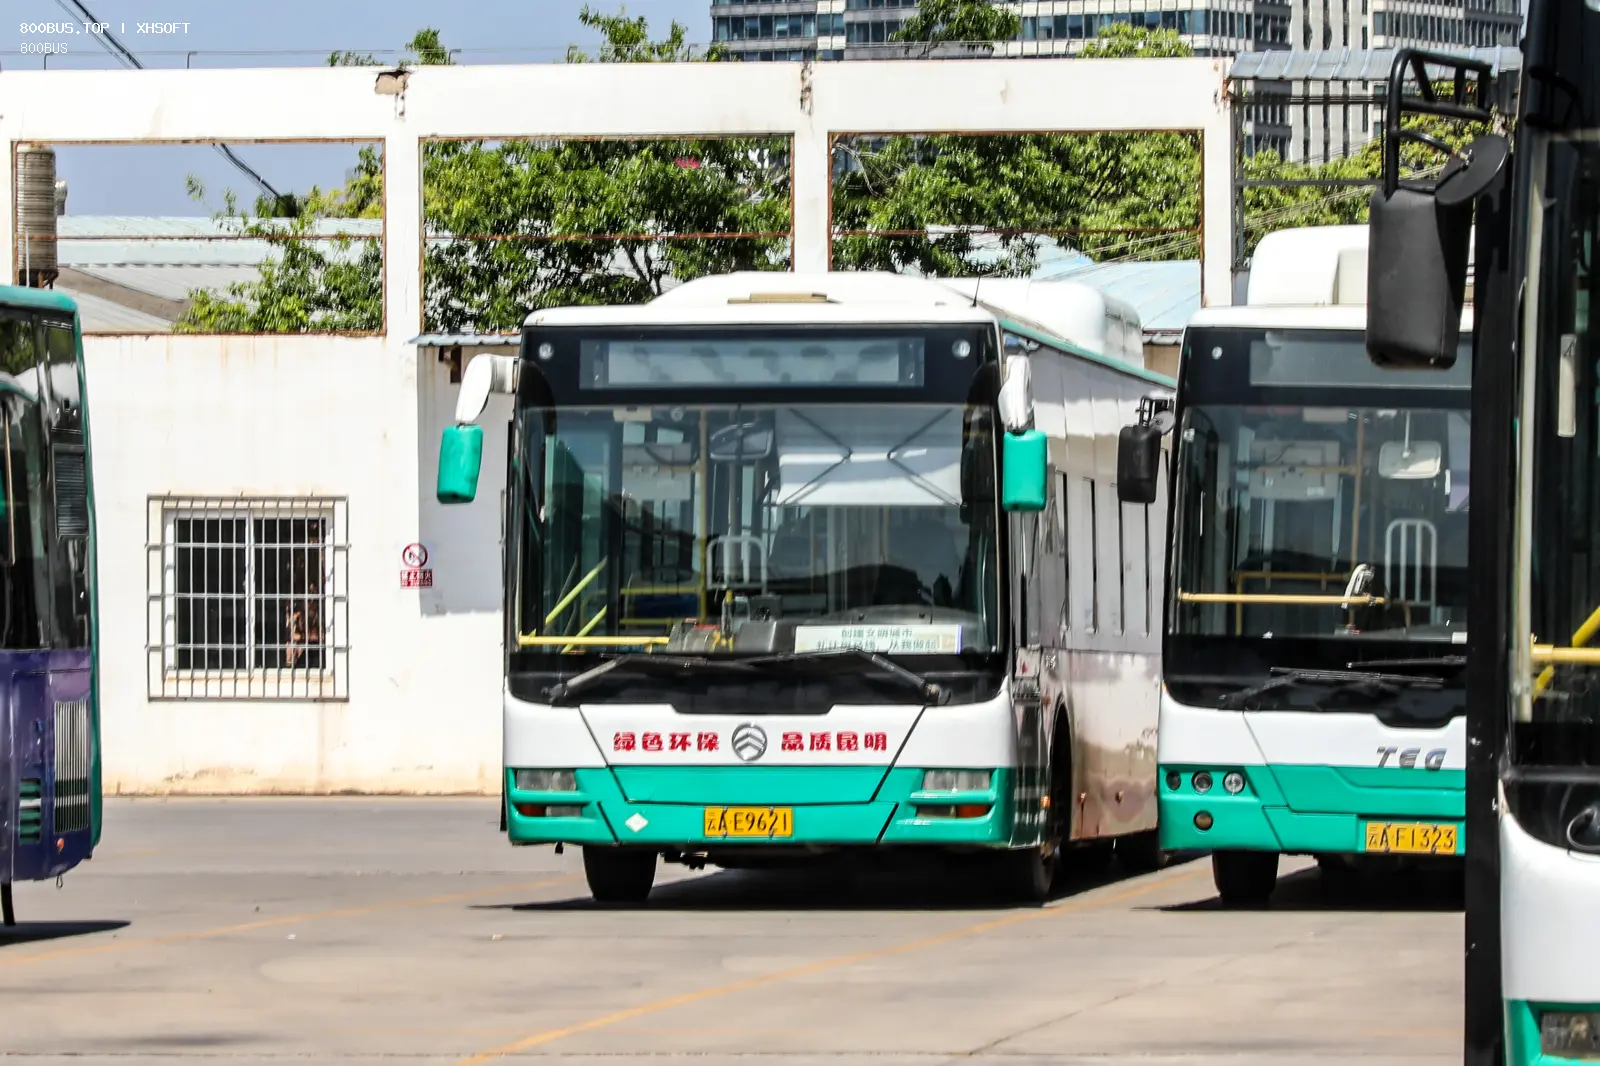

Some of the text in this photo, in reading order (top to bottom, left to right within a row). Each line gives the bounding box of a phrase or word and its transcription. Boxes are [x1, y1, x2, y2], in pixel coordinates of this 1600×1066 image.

[613, 732, 887, 751] 绿色环保 品质昆明
